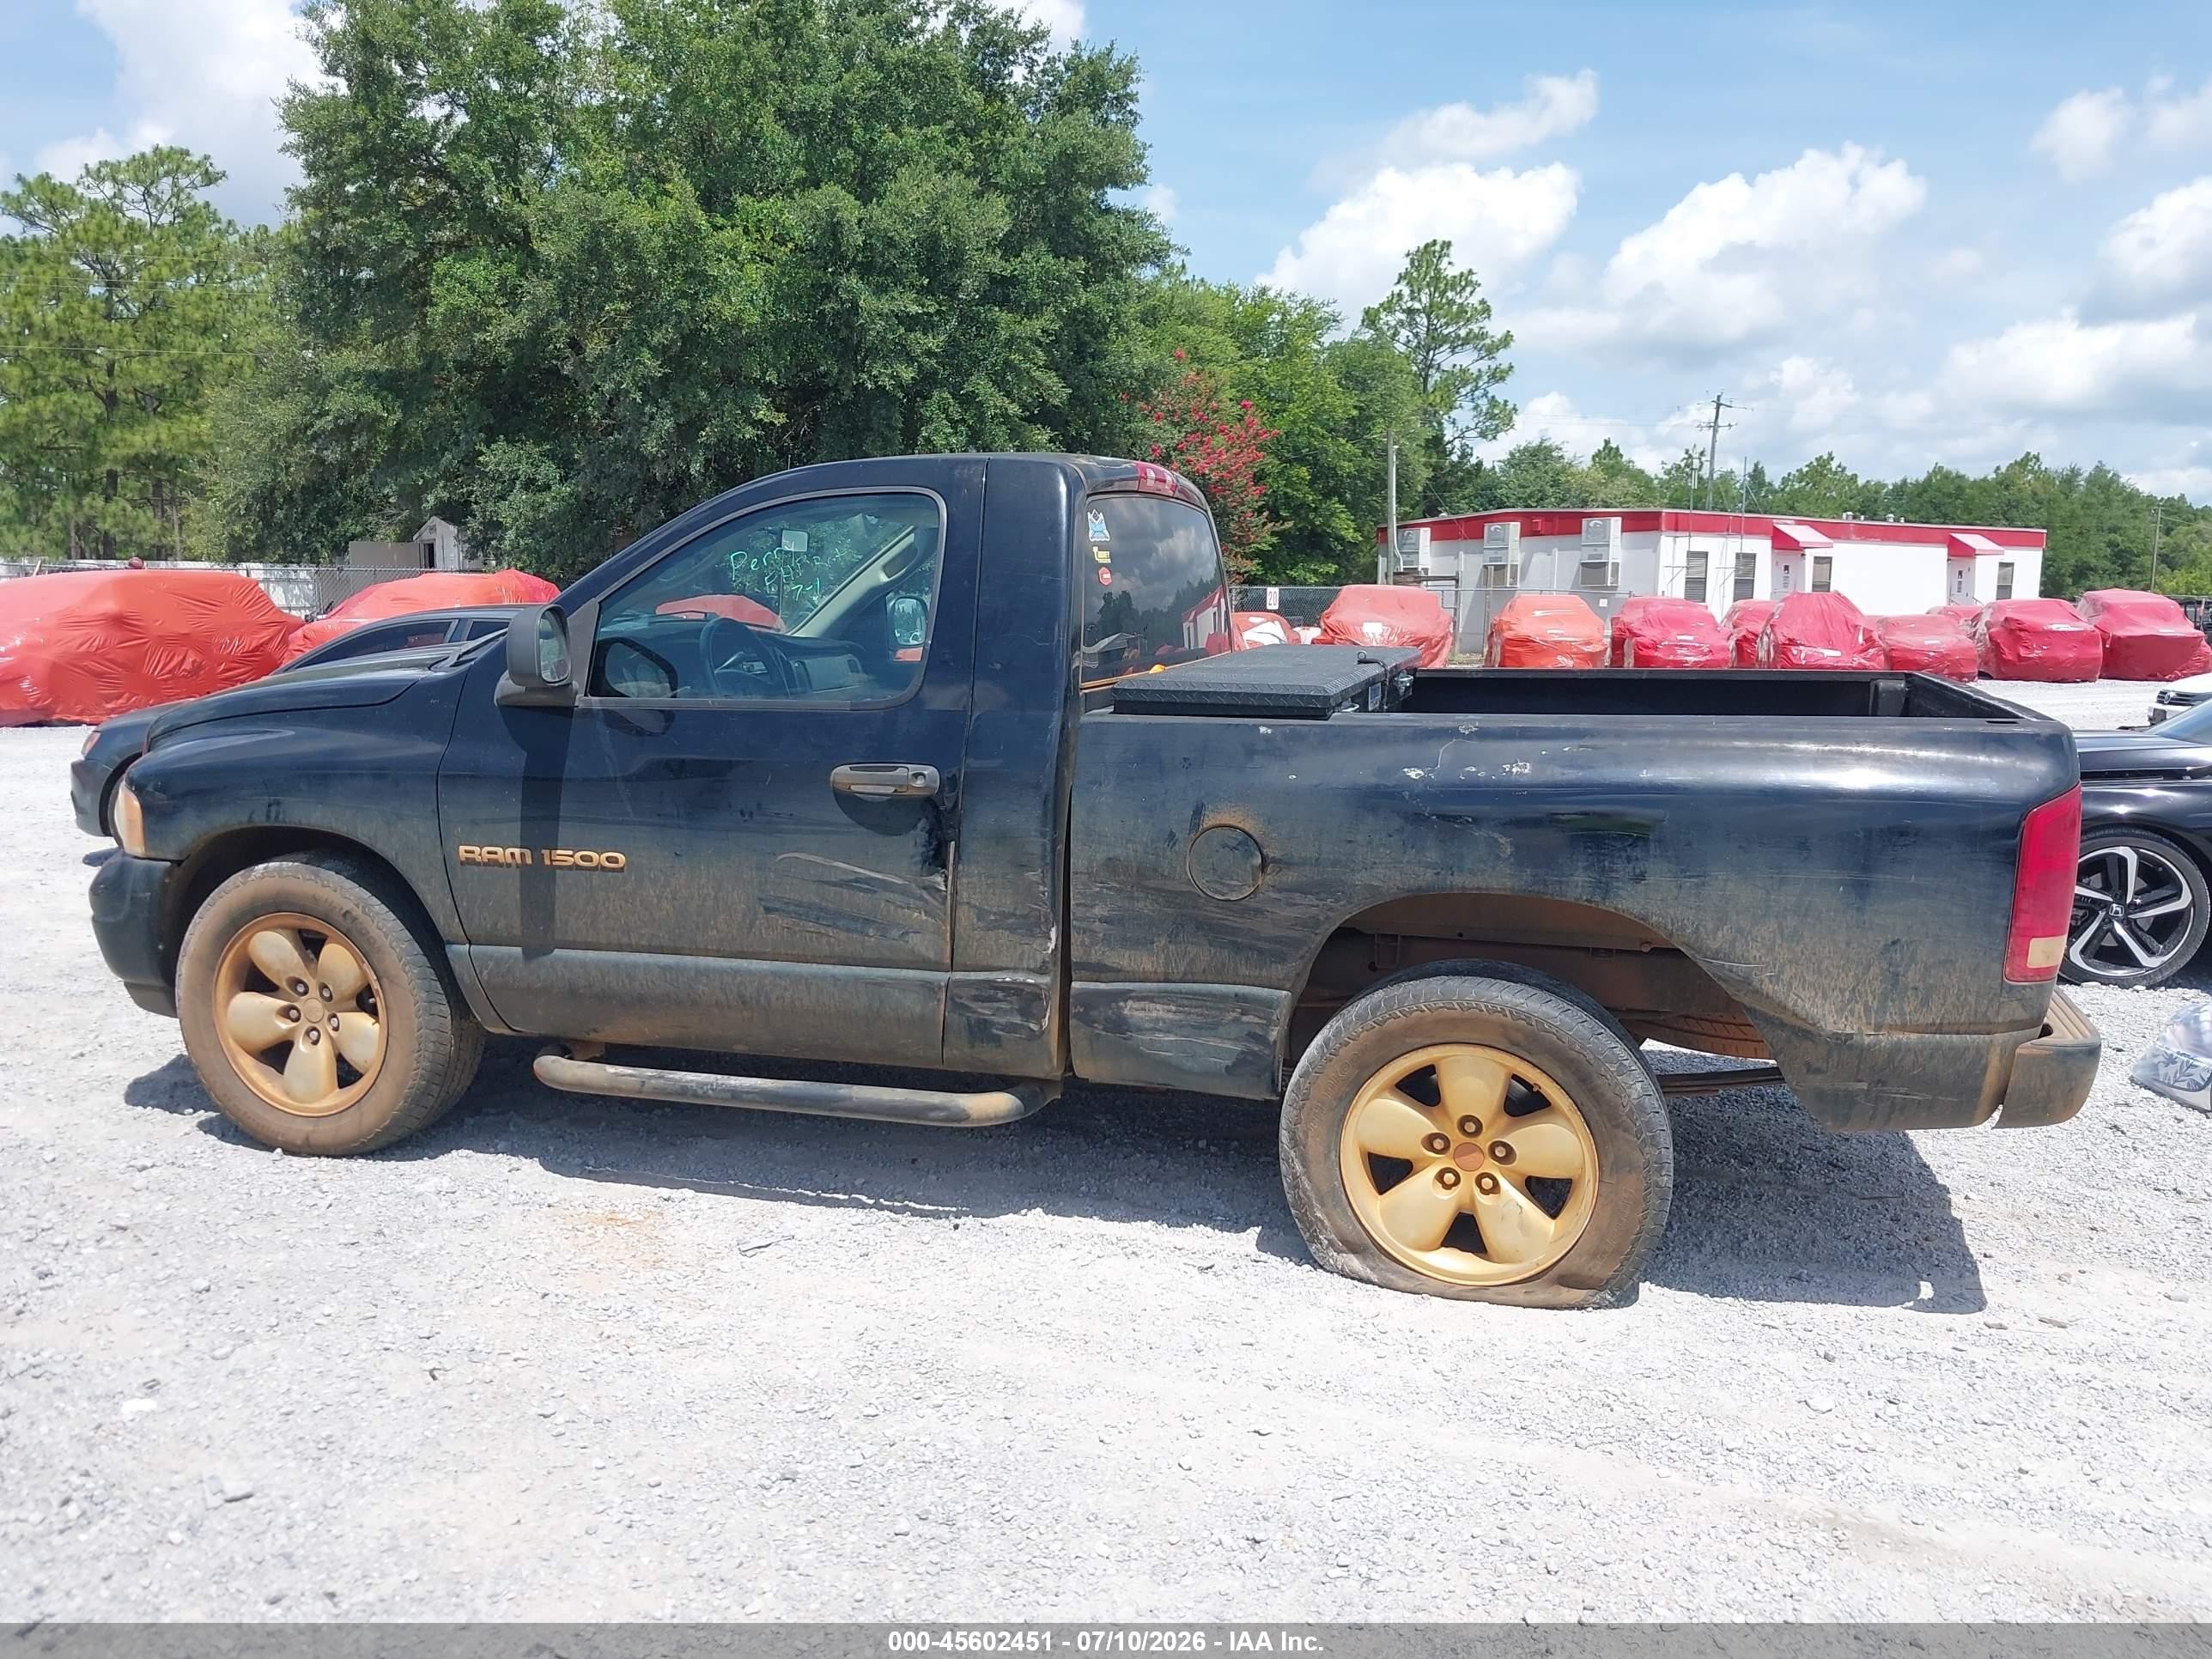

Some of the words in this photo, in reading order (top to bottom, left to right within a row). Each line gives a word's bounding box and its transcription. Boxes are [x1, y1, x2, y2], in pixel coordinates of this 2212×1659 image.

[730, 541, 795, 580] Perry
[1267, 590, 1278, 606] 20
[459, 845, 532, 866] RAM
[541, 848, 627, 869] 1500
